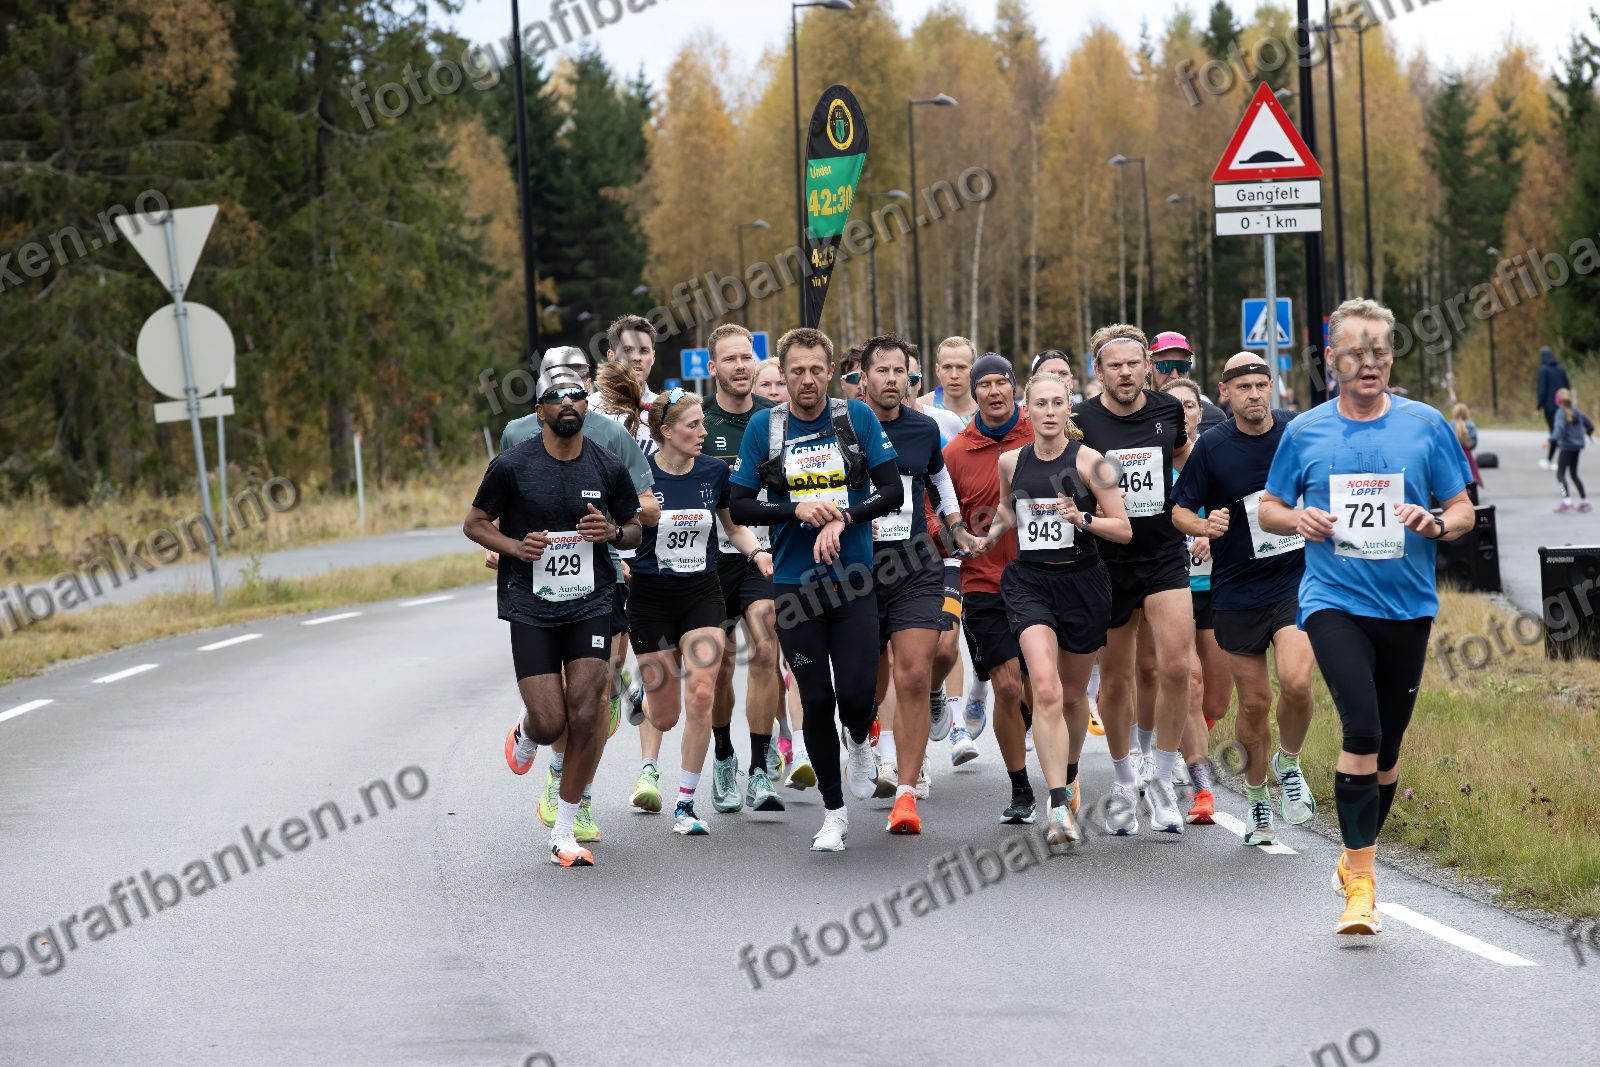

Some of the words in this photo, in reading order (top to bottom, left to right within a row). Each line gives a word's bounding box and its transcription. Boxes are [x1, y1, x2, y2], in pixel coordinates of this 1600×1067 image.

[810, 165, 832, 178] Under
[1236, 187, 1300, 203] Gangfelt
[808, 184, 852, 217] 42:30
[1240, 217, 1250, 229] 0
[1276, 216, 1297, 228] km
[797, 454, 831, 464] NORGES
[1118, 452, 1152, 461] NORGES
[801, 461, 827, 469] LØPET
[1122, 459, 1147, 467] LØPET
[1118, 471, 1153, 493] 464
[1347, 480, 1390, 488] NORGES
[1351, 488, 1383, 496] LØPET
[1028, 503, 1057, 511] NORGE
[671, 513, 703, 521] NORGES
[1345, 503, 1387, 529] 721
[1028, 520, 1063, 542] 943
[666, 530, 700, 549] 397
[1362, 539, 1402, 550] Aurskog
[550, 542, 577, 550] LØPET
[545, 553, 581, 577] 429
[558, 585, 592, 594] Aurskog
